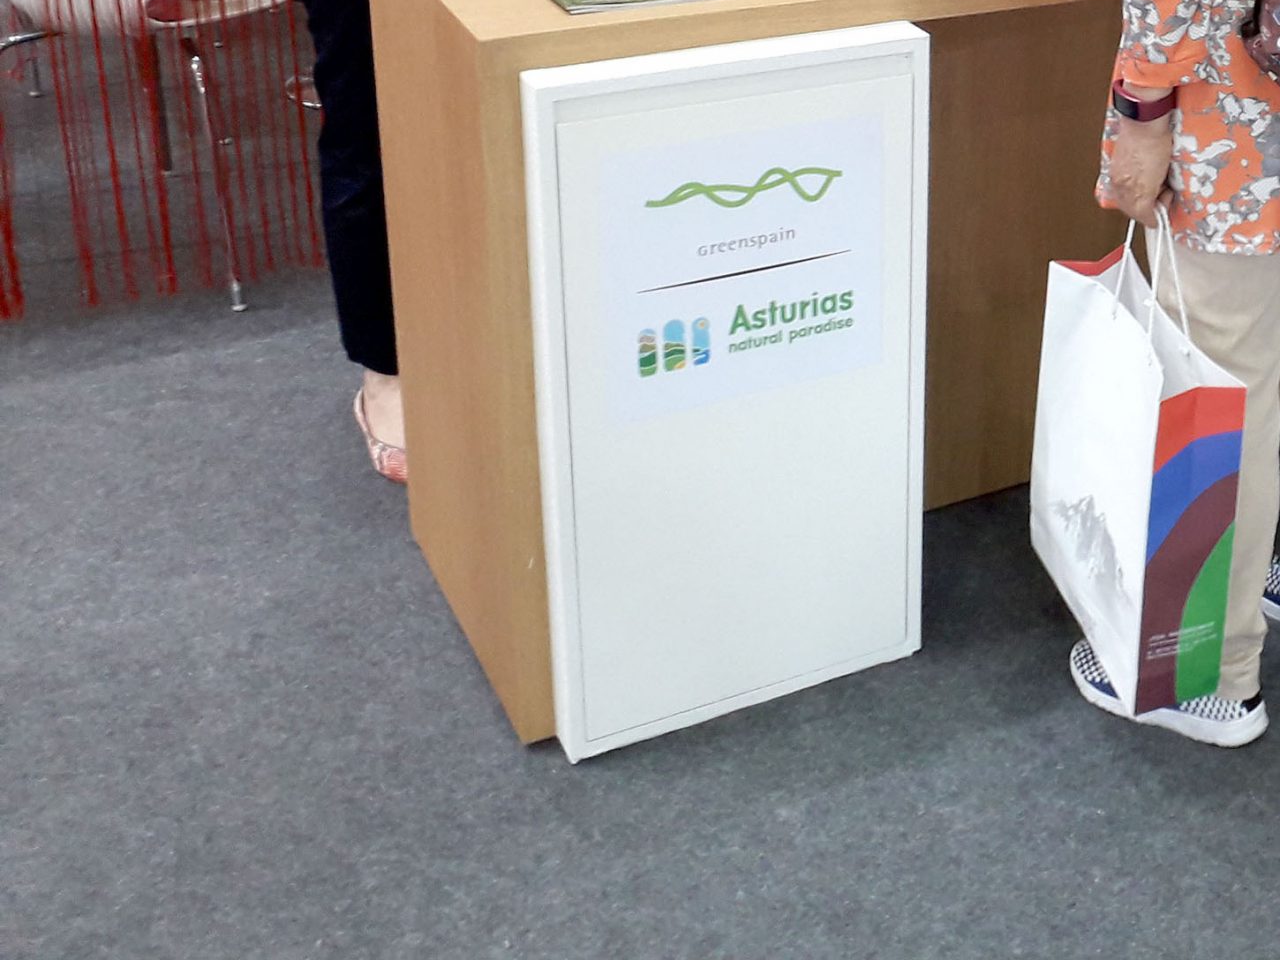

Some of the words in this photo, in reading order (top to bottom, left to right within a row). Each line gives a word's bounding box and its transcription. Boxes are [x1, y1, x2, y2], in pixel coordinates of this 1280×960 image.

[729, 290, 854, 335] Asturias
[728, 330, 783, 353] natural
[789, 317, 854, 344] paradise
